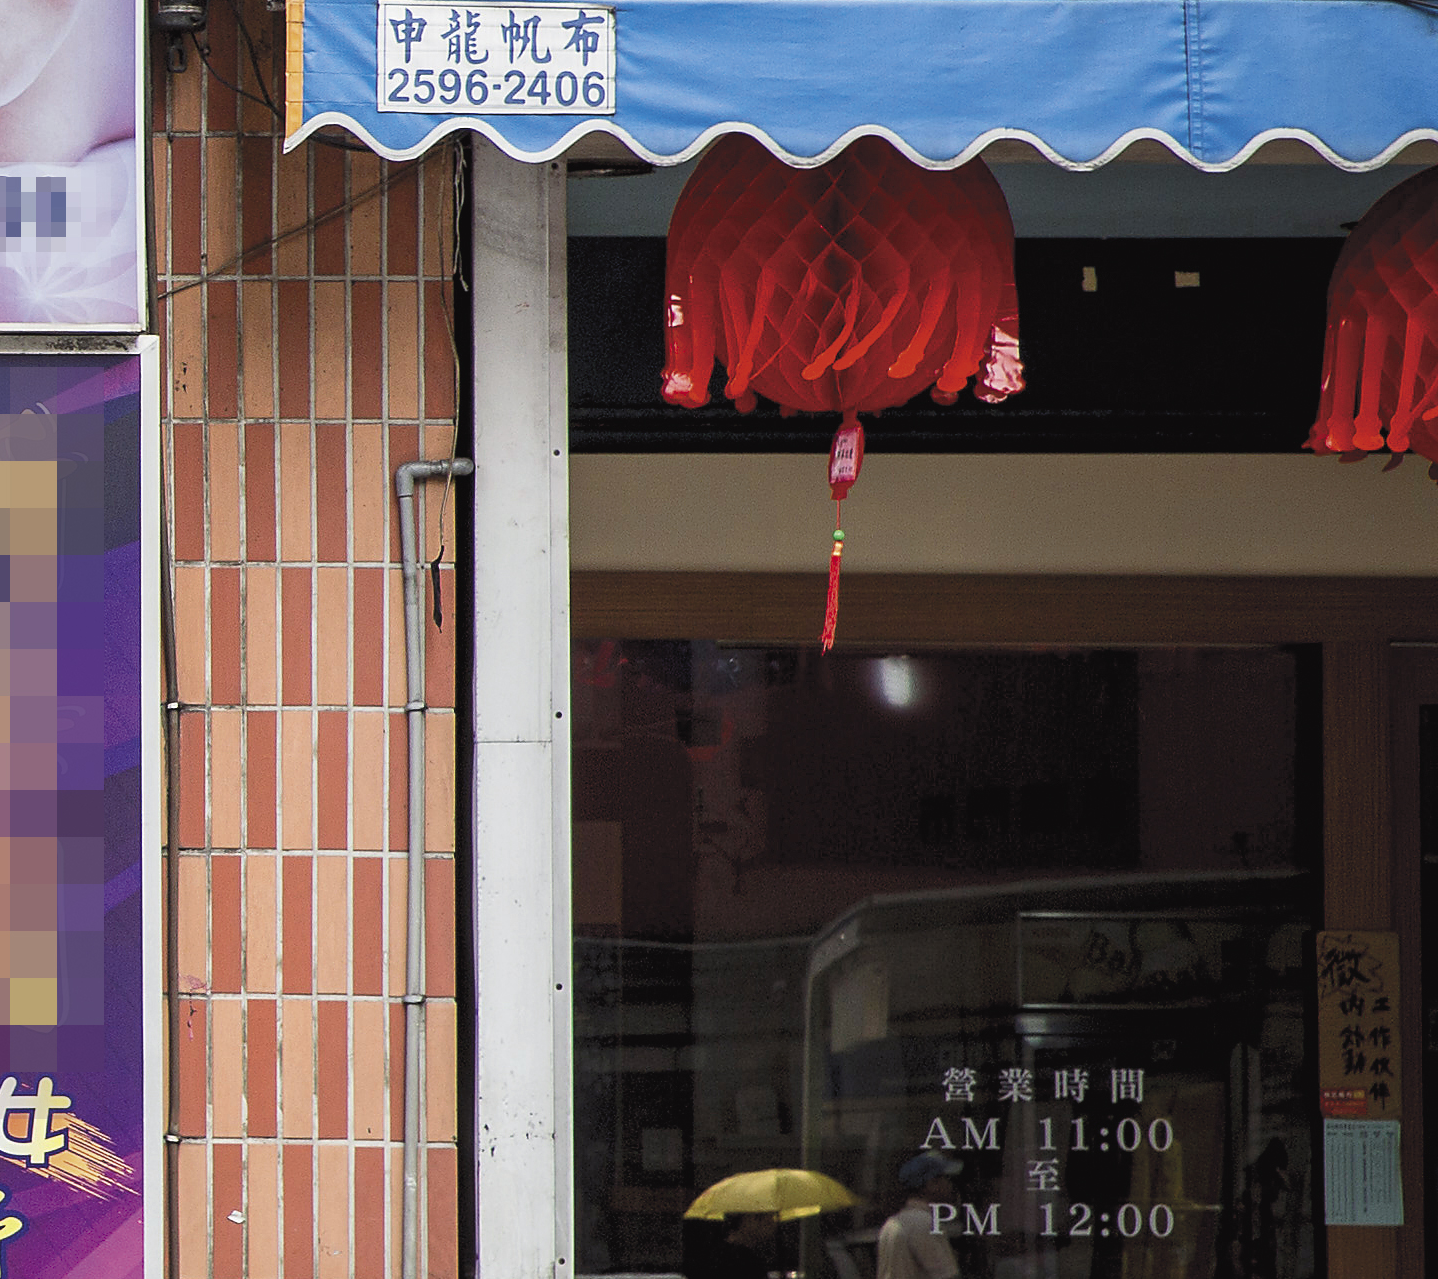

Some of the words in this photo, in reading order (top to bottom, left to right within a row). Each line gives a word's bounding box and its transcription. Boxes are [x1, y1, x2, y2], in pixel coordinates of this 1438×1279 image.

[388, 8, 605, 66] 申龍帆布
[388, 68, 606, 107] 2596-2406
[942, 1066, 1145, 1104] 營業時間
[919, 1117, 1001, 1150] AM
[1039, 1117, 1174, 1152] 11:00
[1026, 1158, 1061, 1191] 至
[928, 1203, 1002, 1236] PM
[1039, 1203, 1175, 1238] 12:00
